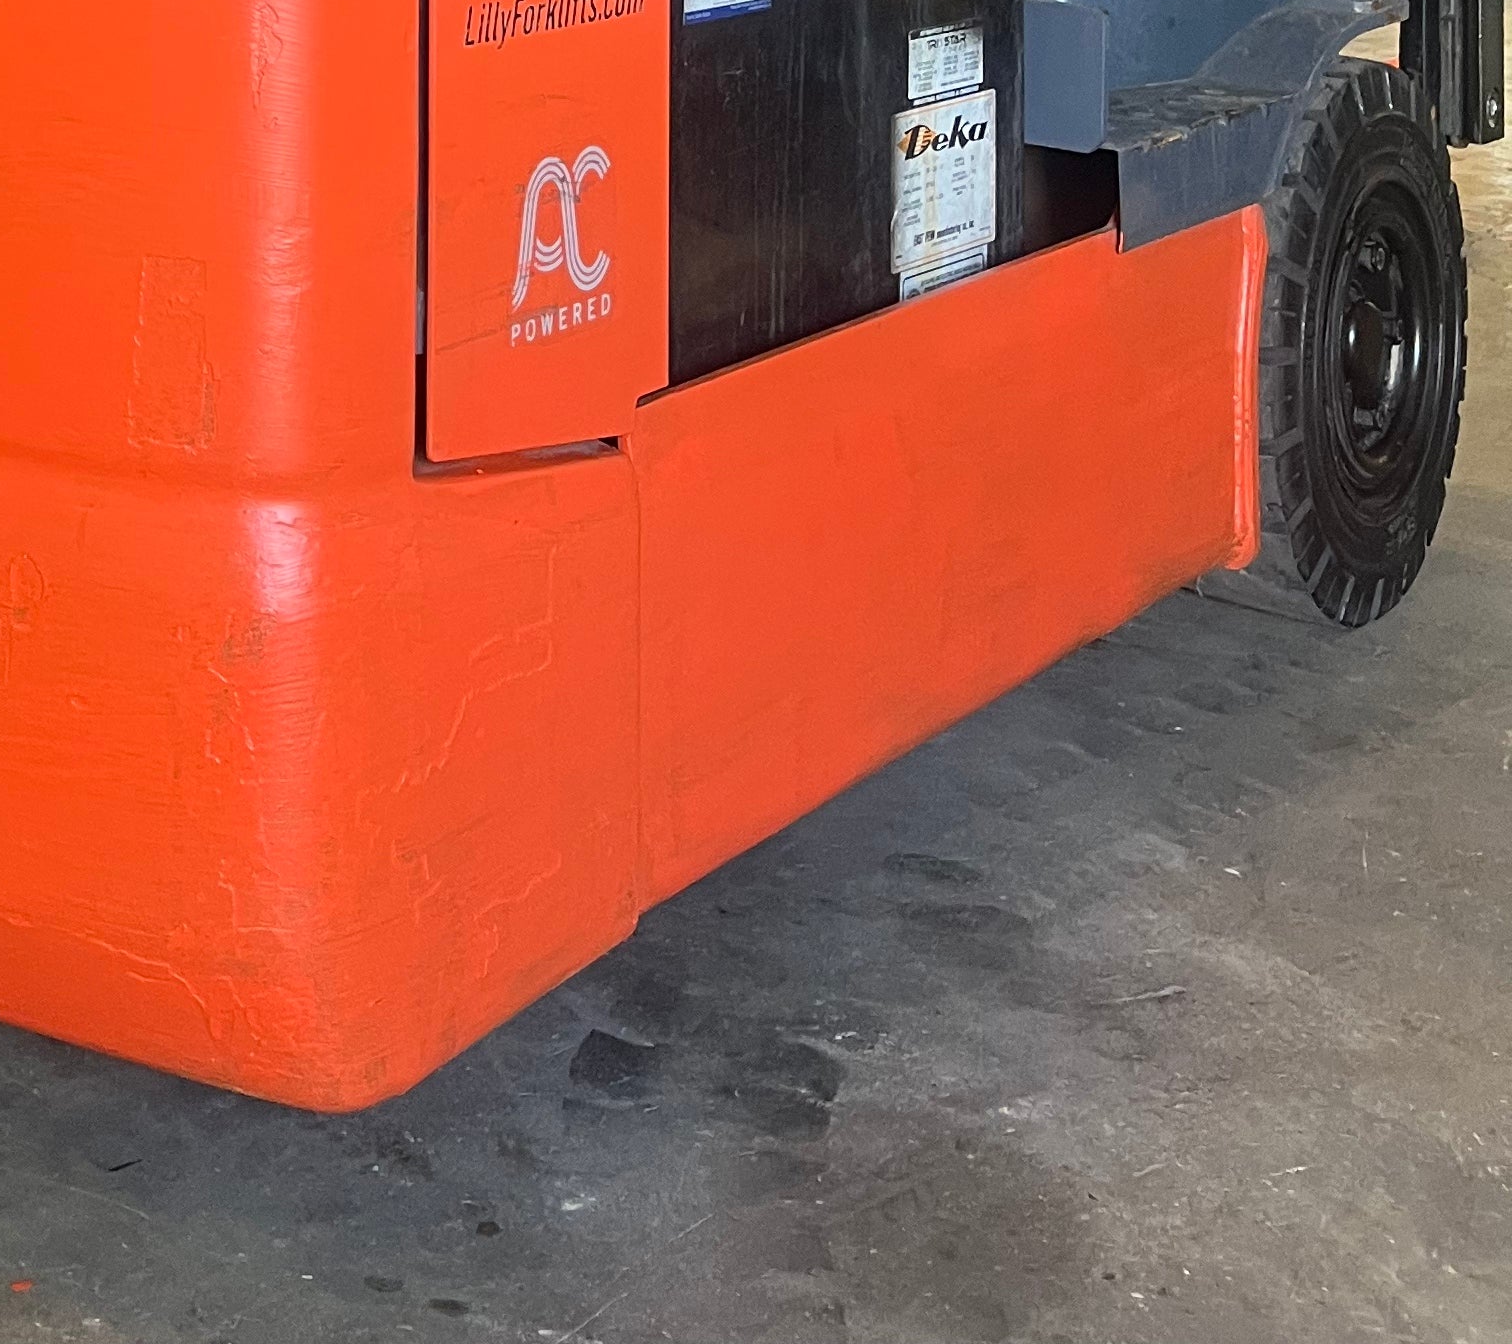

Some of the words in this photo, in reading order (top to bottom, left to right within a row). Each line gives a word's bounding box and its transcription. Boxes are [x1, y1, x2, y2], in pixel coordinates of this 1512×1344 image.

[904, 114, 989, 161] Deka
[512, 145, 611, 311] AC
[511, 292, 612, 348] POWERED
